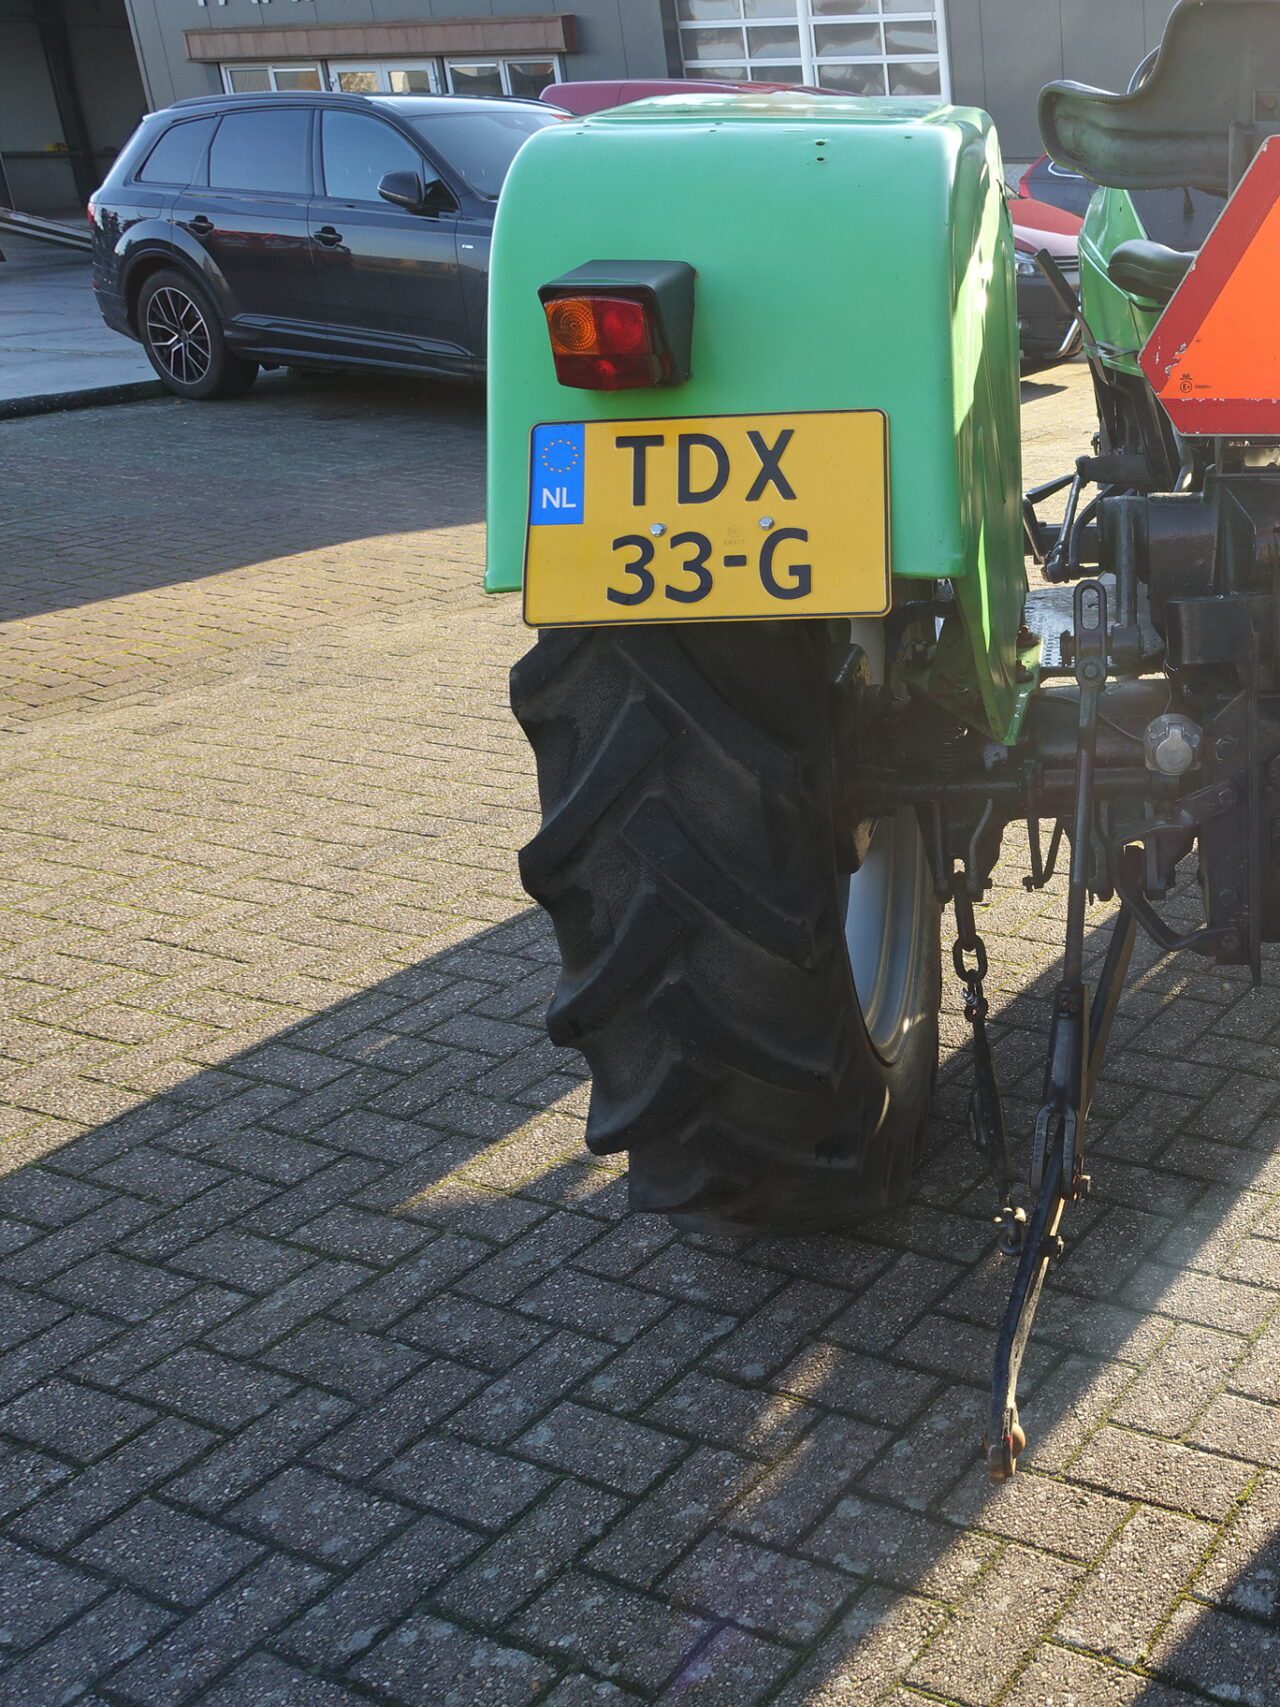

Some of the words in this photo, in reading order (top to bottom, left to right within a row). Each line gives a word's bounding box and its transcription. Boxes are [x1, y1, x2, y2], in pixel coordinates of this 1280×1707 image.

[541, 487, 576, 509] NL
[615, 429, 796, 507] TDX
[606, 528, 812, 606] 33-G
